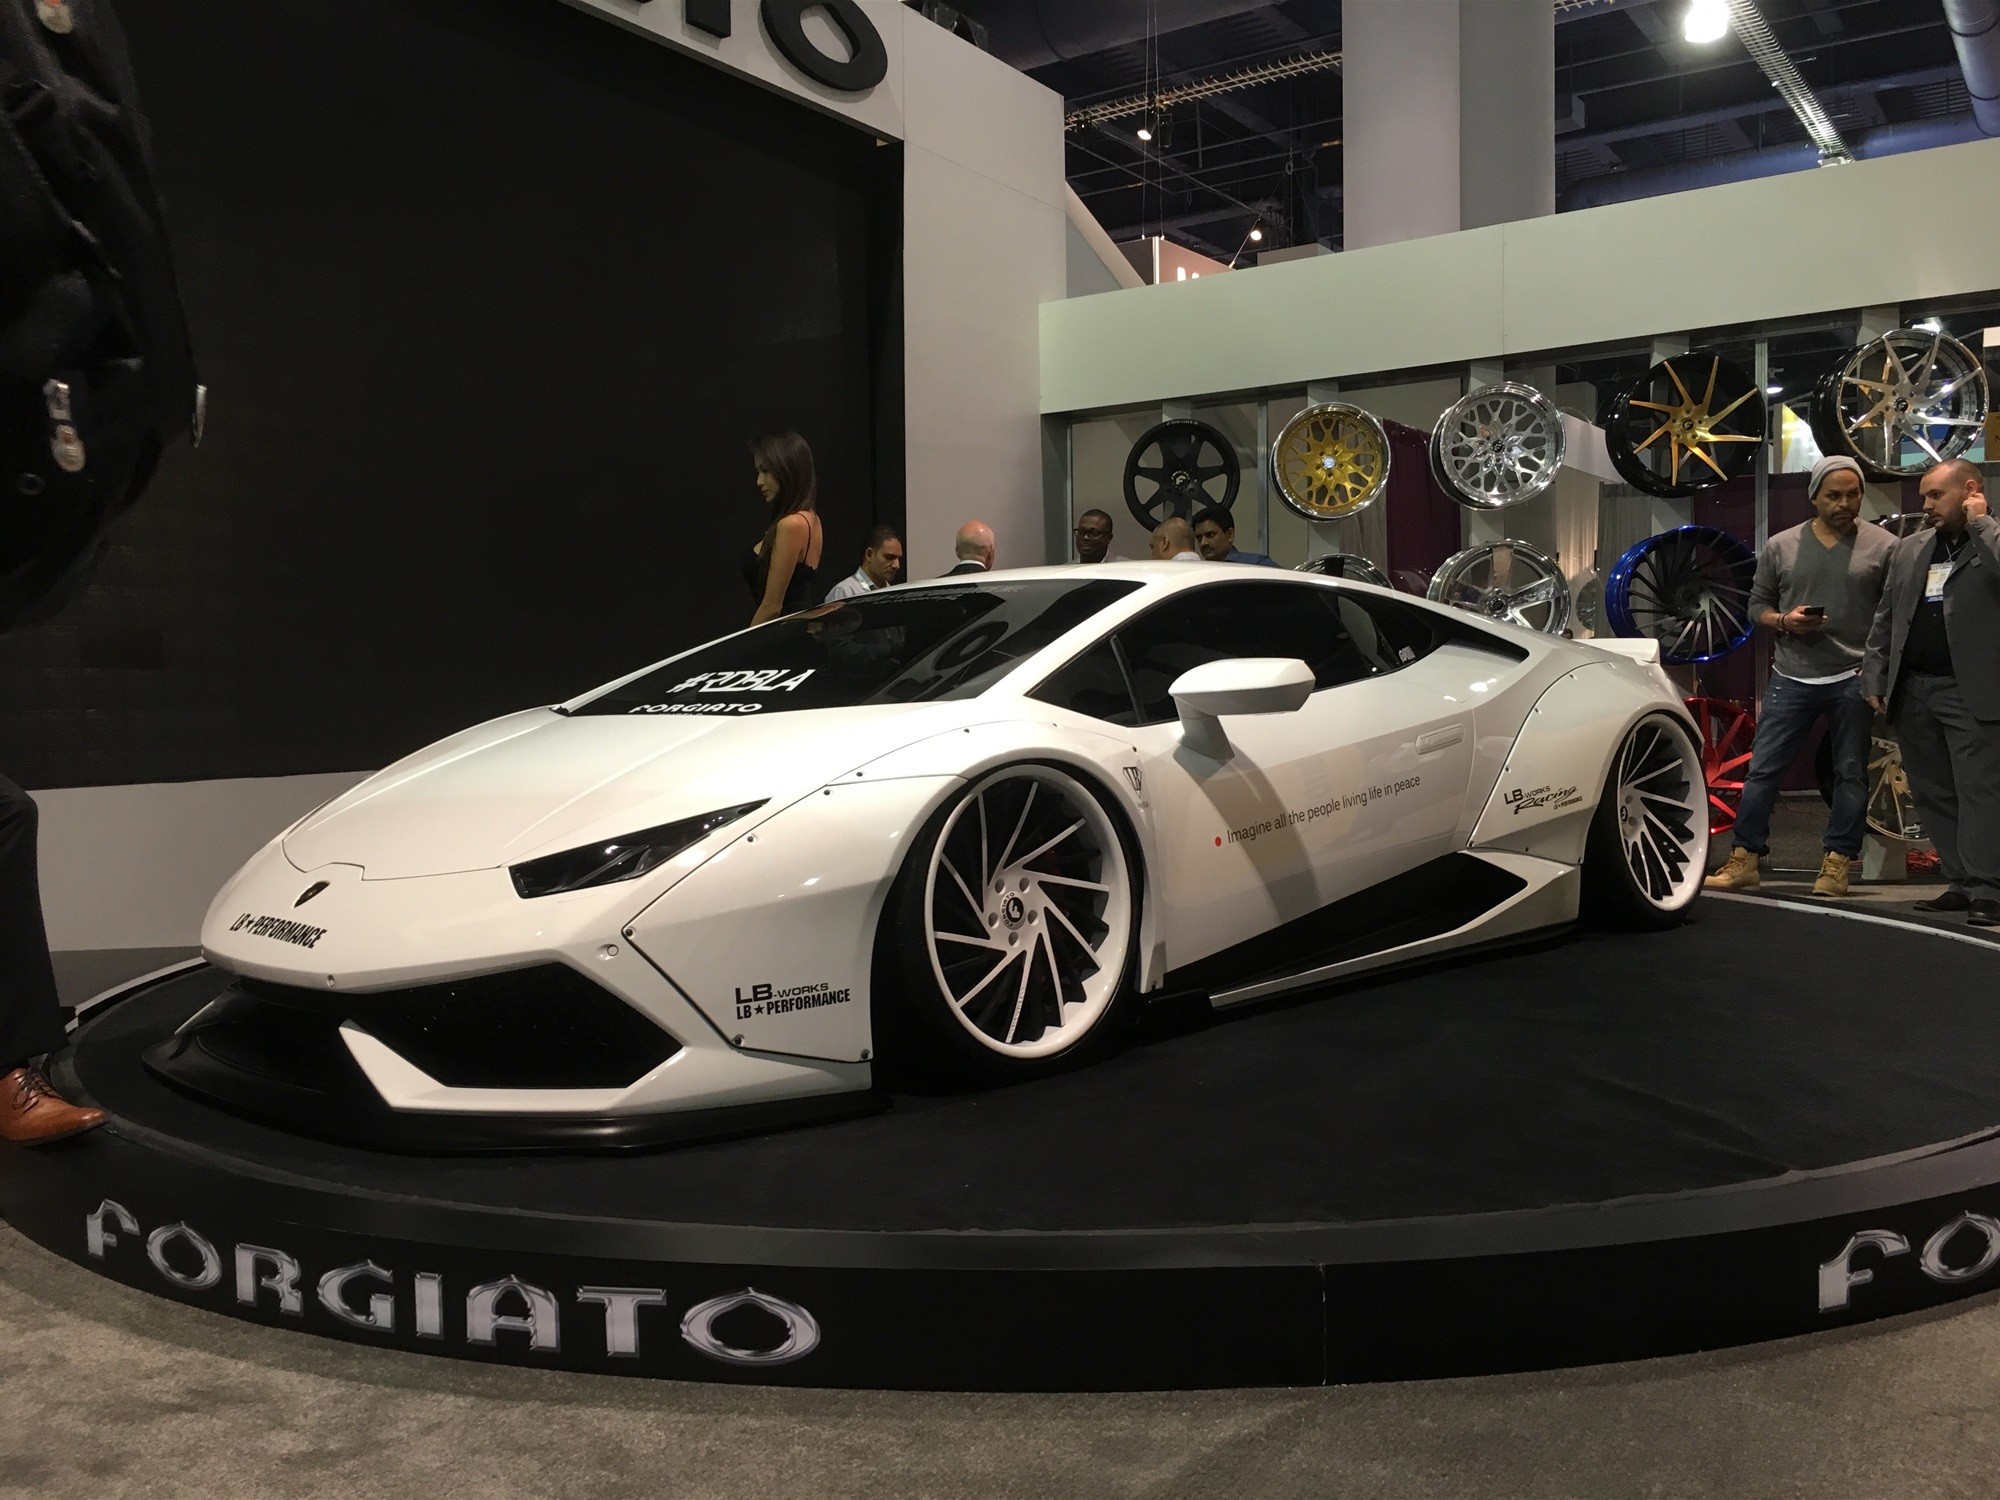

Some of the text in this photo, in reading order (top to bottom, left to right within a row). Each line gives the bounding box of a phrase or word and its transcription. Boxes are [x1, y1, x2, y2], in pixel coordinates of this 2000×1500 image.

[628, 703, 763, 713] FORGIATO
[1227, 775, 1421, 844] Imagine all the people living life in peace
[1513, 786, 1577, 814] Racing
[229, 912, 328, 949] LB PERFORMANCE
[736, 988, 851, 1020] LB PERFORMANCE
[86, 1199, 820, 1366] FORGIATO
